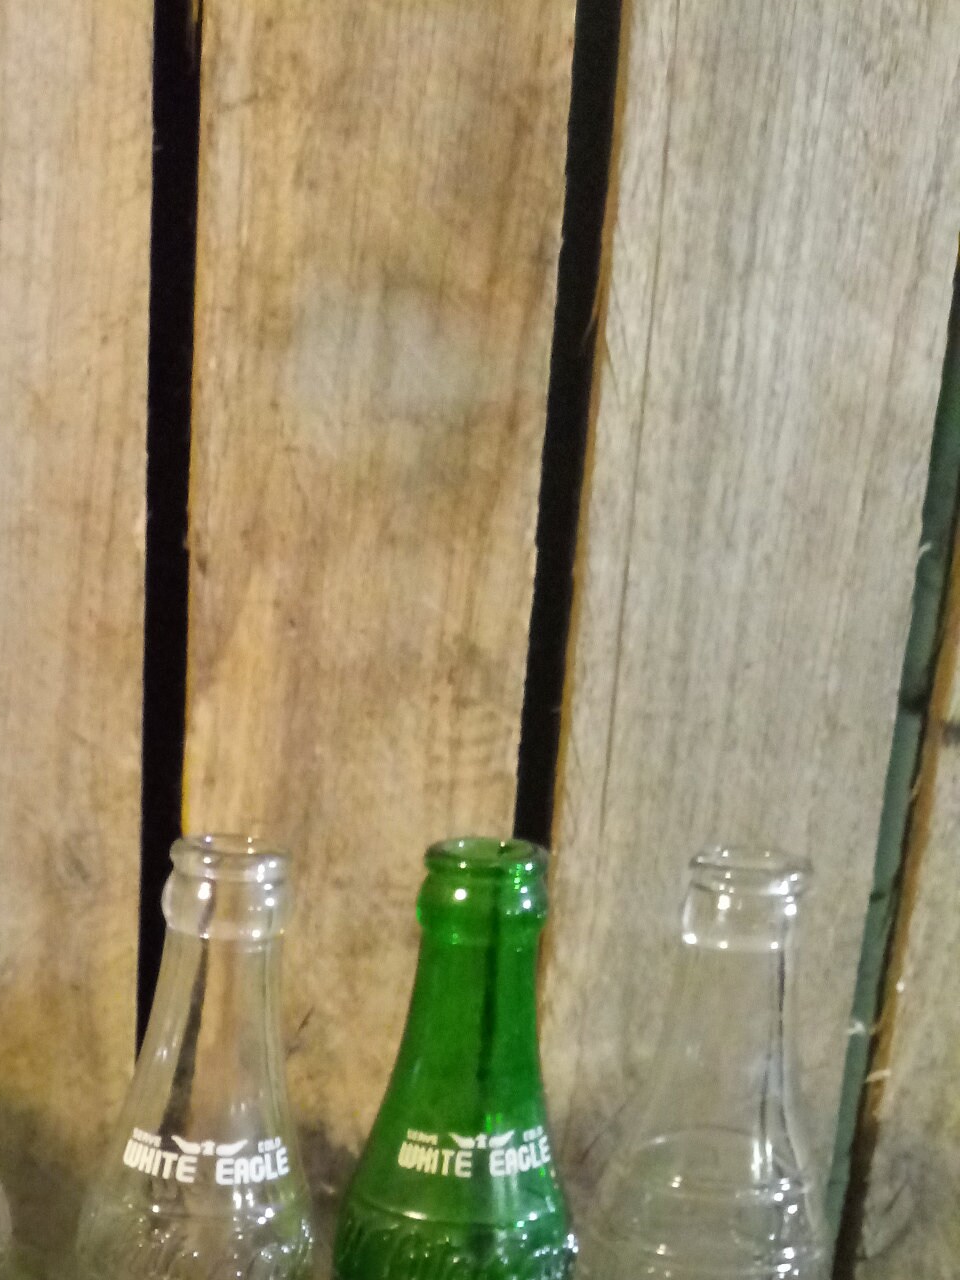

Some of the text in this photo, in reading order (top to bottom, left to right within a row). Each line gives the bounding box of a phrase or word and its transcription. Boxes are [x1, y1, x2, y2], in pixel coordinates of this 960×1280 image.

[123, 1138, 290, 1186] WHITE EAGLE
[398, 1136, 551, 1179] WHITE EAGLE
